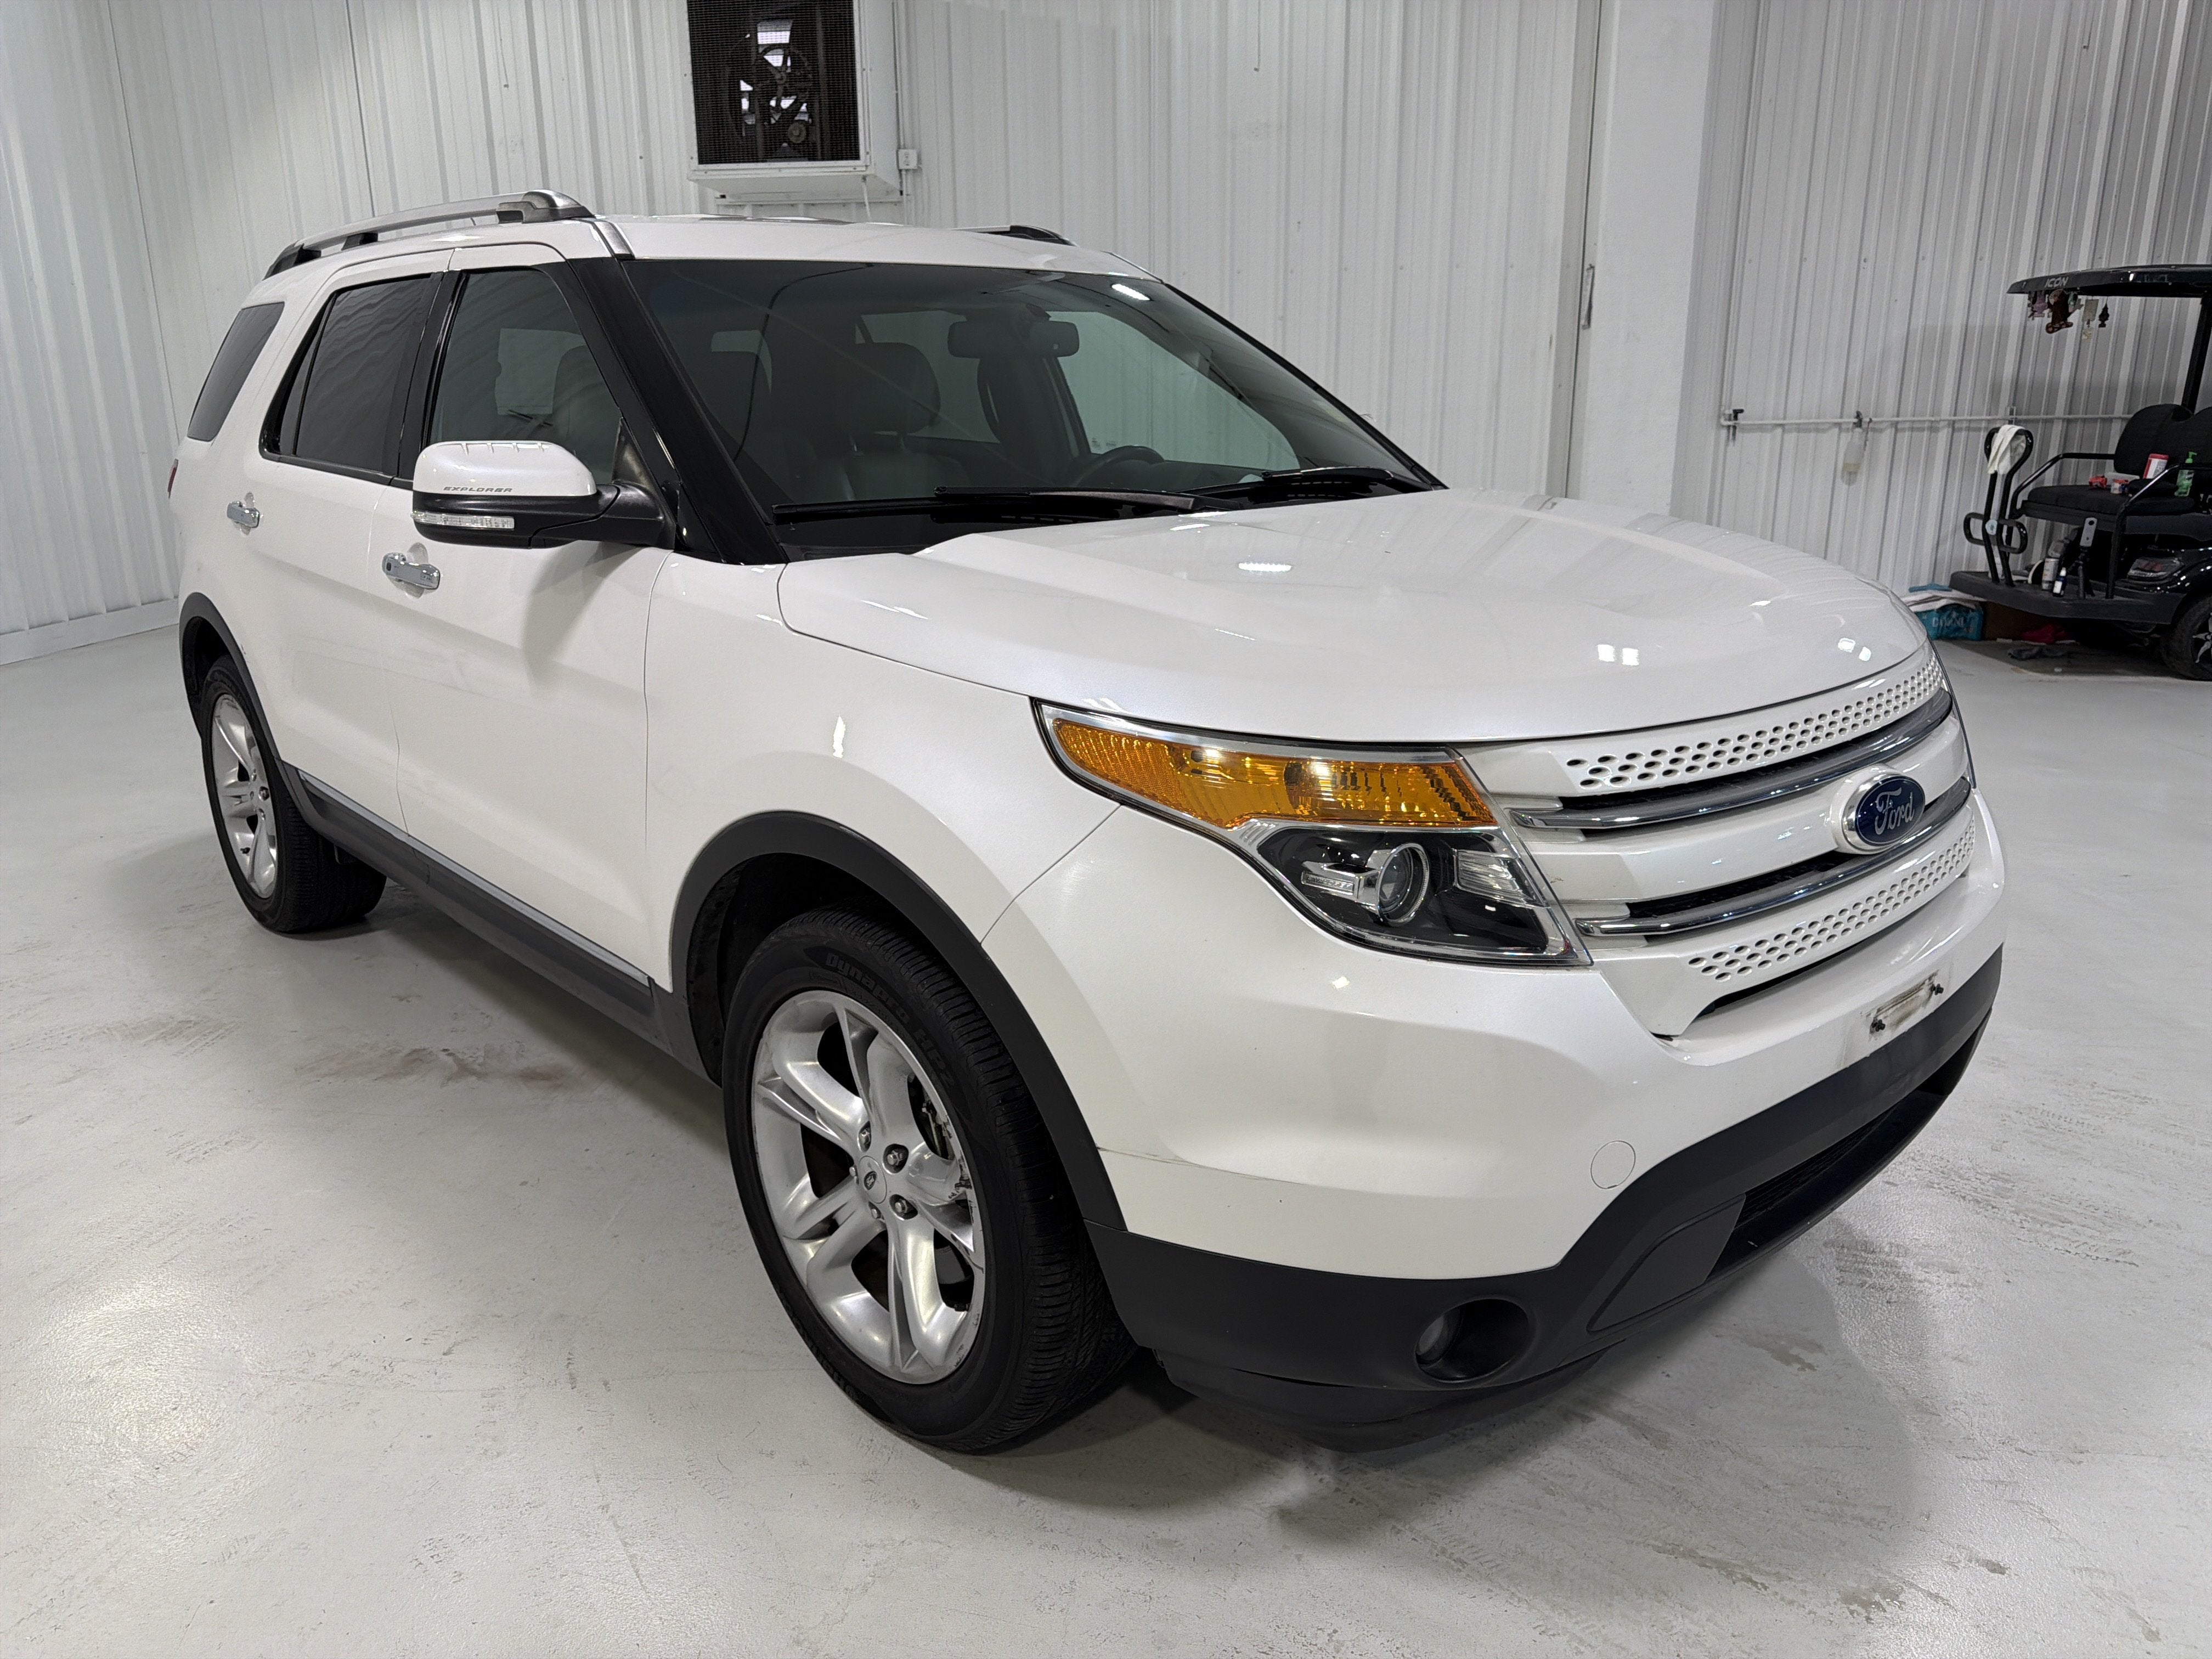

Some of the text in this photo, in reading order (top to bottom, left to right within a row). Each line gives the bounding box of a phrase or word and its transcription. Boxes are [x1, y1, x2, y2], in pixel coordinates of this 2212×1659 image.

[2044, 276, 2069, 288] ICON
[1874, 787, 1915, 835] Ford
[825, 951, 910, 1024] Dynapro
